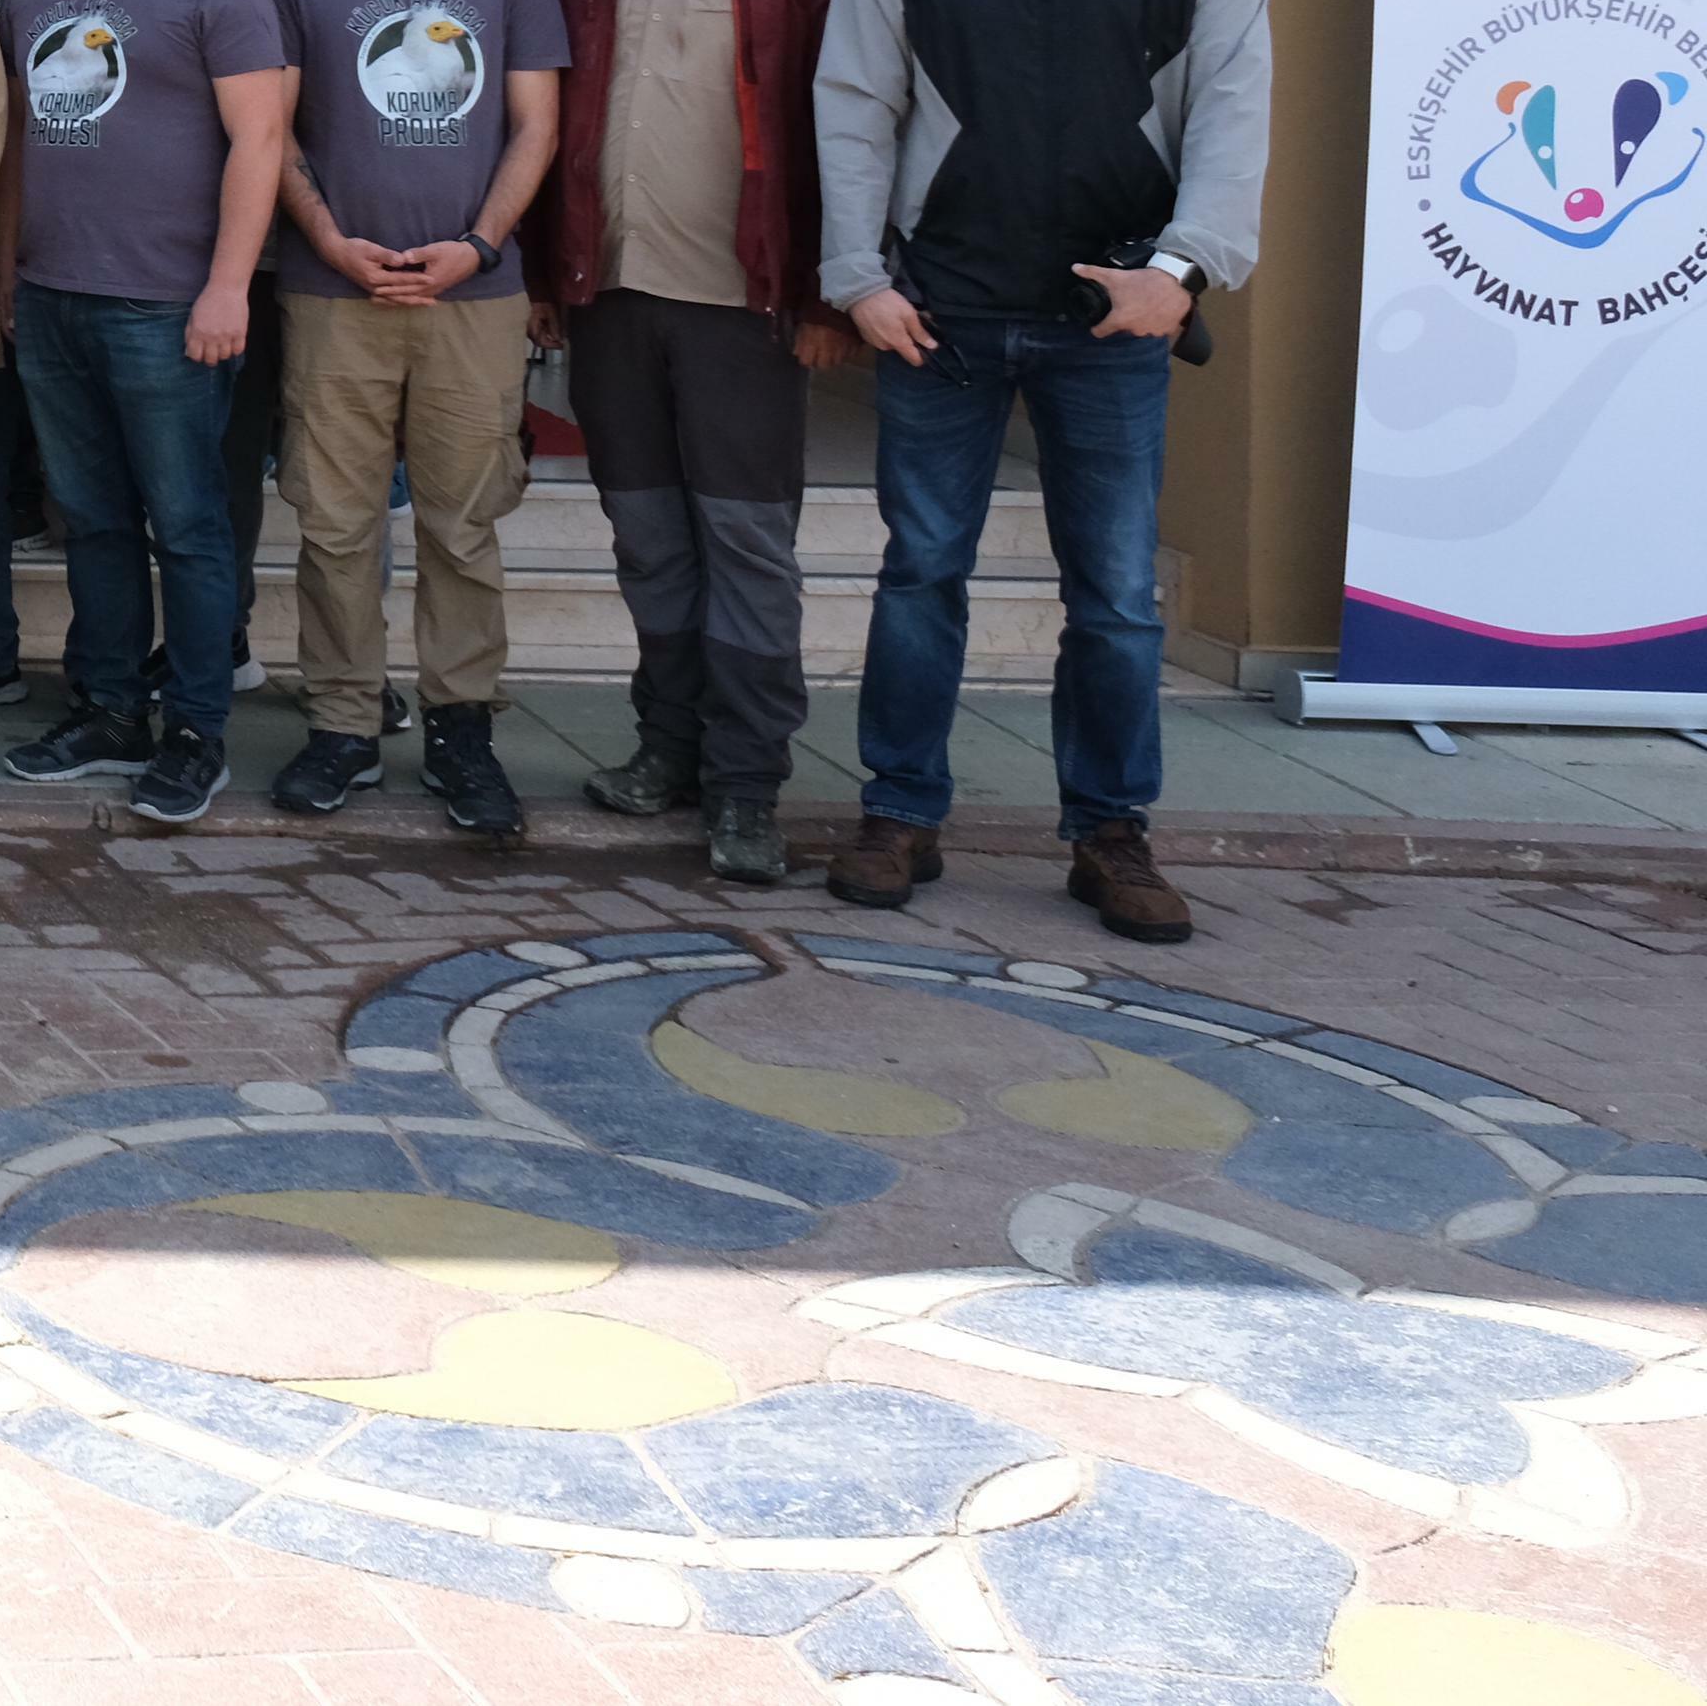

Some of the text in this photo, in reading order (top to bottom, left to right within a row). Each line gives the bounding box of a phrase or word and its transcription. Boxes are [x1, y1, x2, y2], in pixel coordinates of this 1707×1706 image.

[37, 92, 96, 115] KORUMA
[387, 89, 459, 114] KORUMA
[1407, 35, 1486, 181] ESKİŞEHİR
[1421, 222, 1580, 327] HAYVANAT
